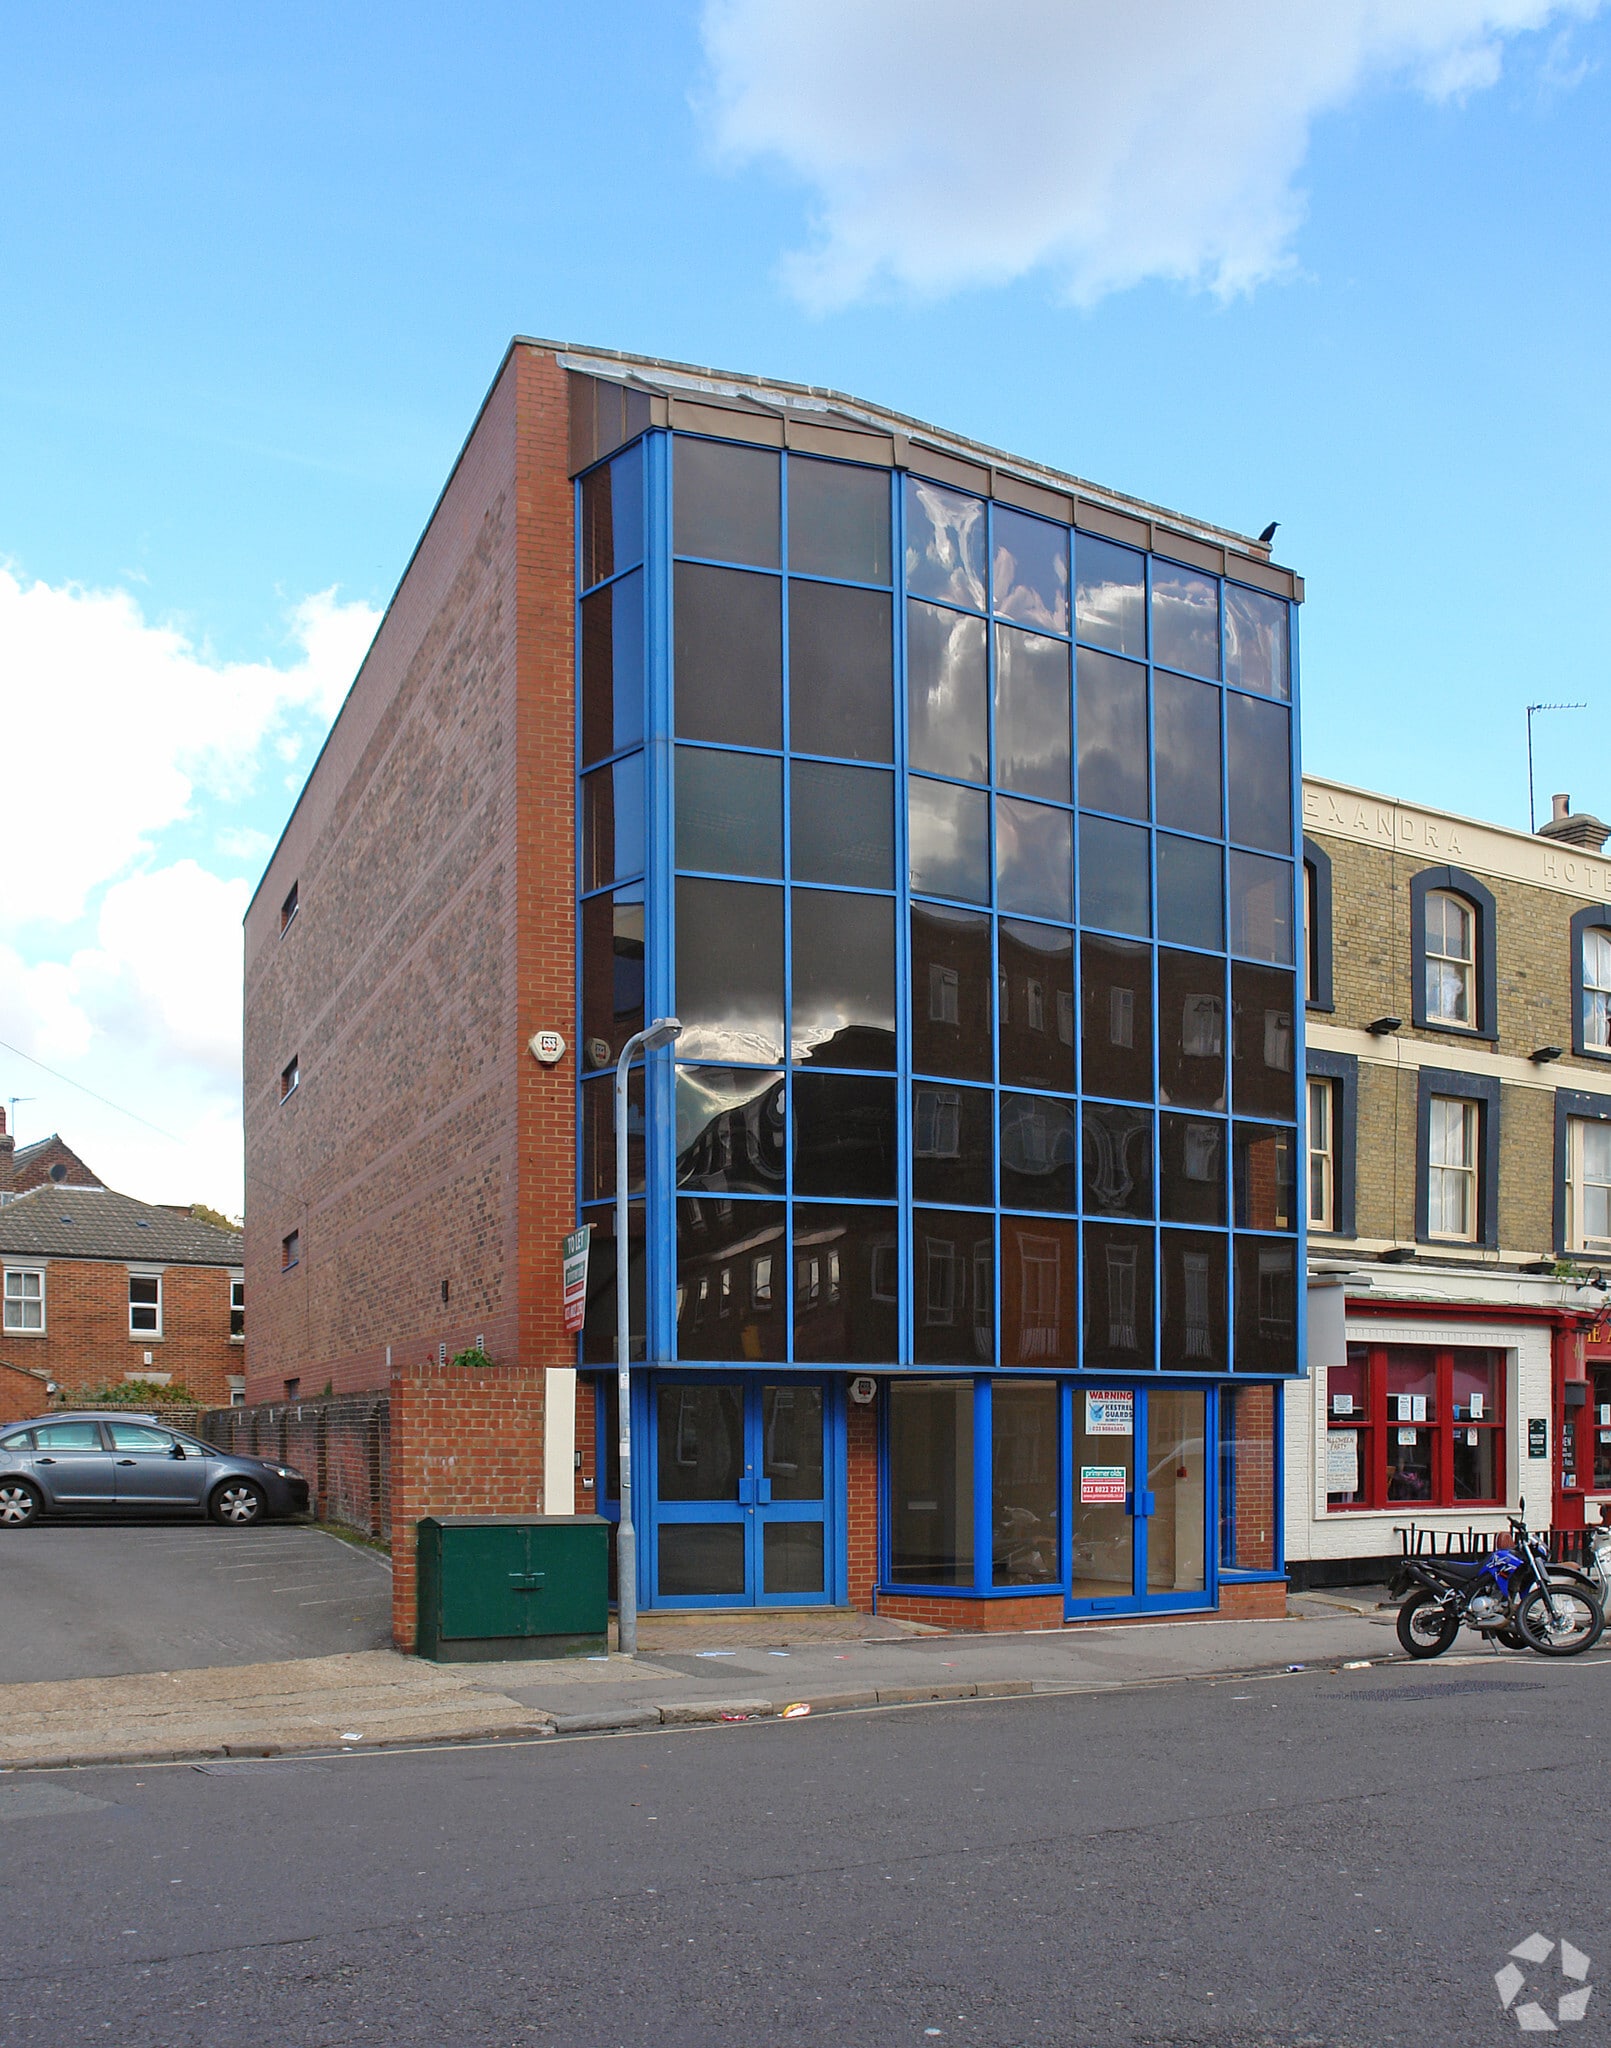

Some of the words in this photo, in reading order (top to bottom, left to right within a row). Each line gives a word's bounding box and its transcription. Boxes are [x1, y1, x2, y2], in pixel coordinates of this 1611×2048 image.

[1303, 788, 1463, 855] EXANDRA
[567, 1236, 575, 1254] TO
[575, 1230, 585, 1252] LET
[1090, 1391, 1133, 1400] WARNING
